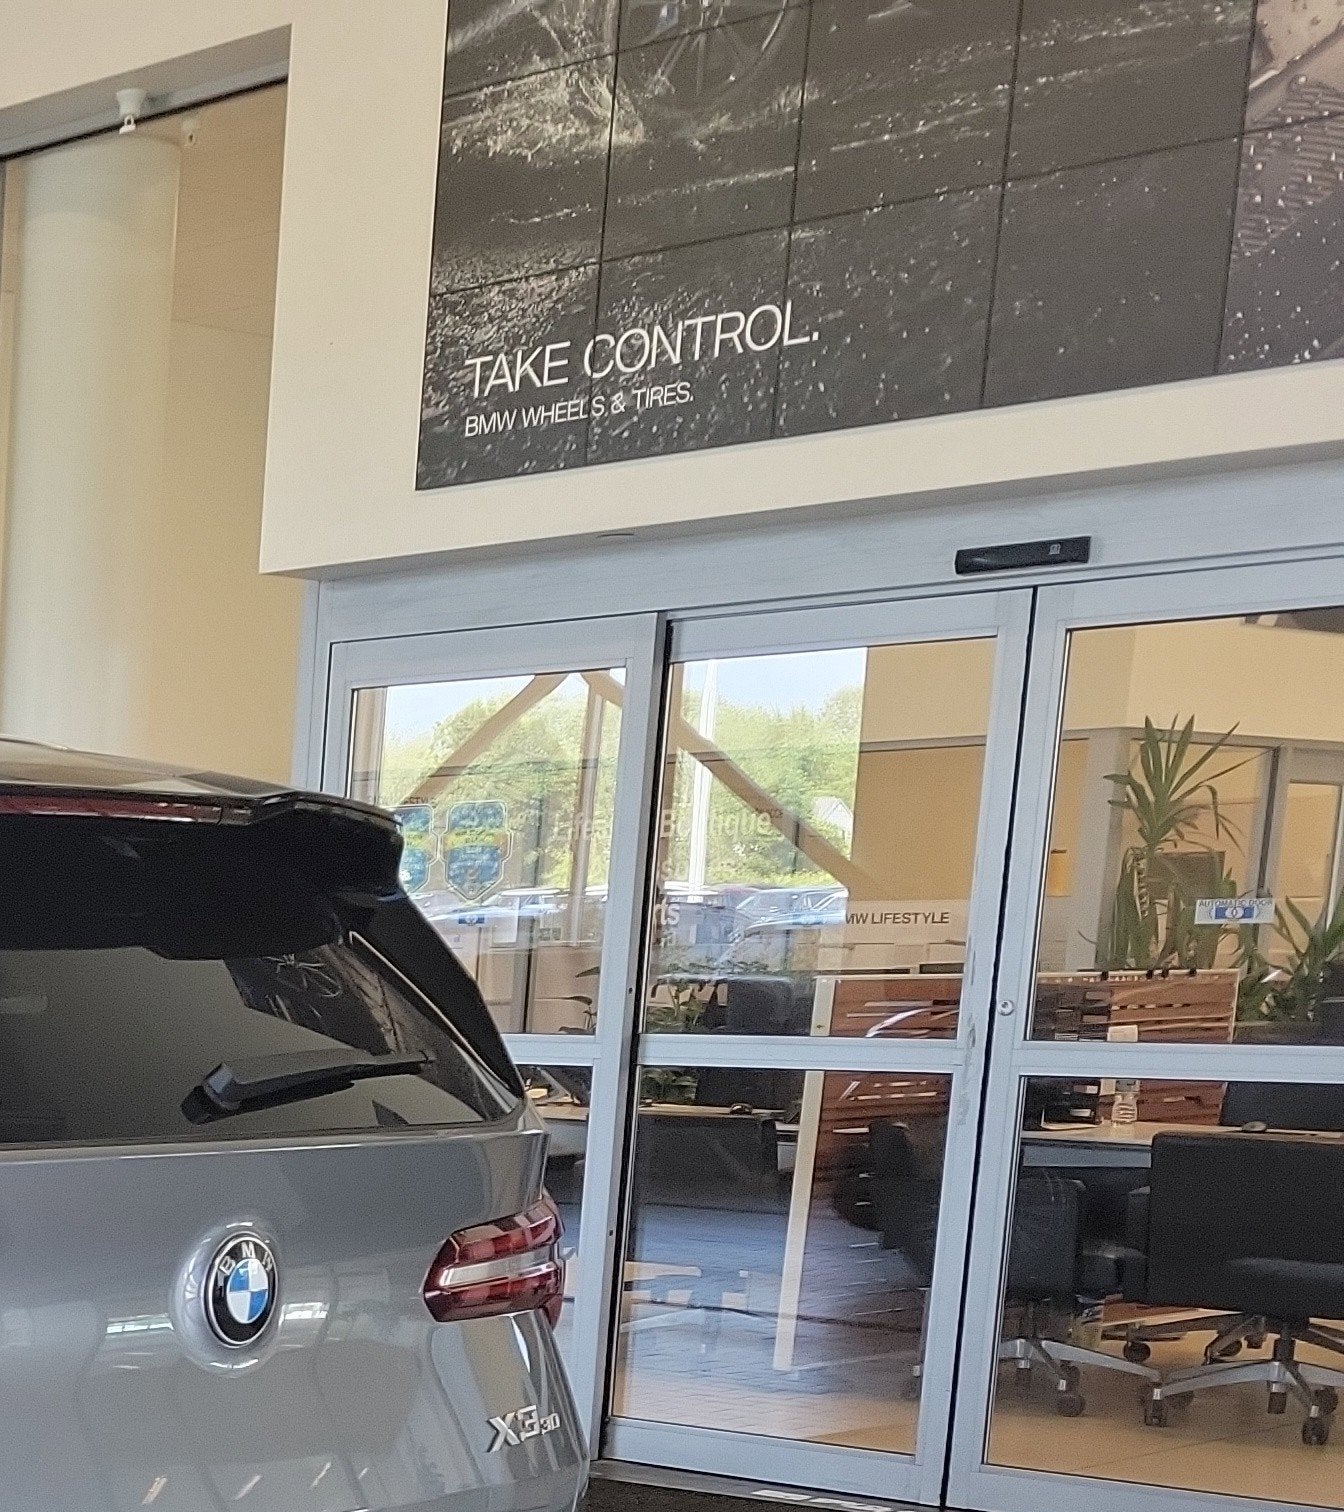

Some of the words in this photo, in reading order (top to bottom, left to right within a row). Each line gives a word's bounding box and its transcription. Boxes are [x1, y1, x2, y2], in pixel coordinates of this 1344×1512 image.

[465, 341, 571, 399] TAKE
[583, 299, 820, 379] CONTROL.
[464, 408, 518, 438] BMW
[522, 394, 606, 429] WHEELS
[610, 393, 626, 414] &
[633, 381, 694, 411] TIRES.
[871, 911, 950, 925] LIFESTYLE
